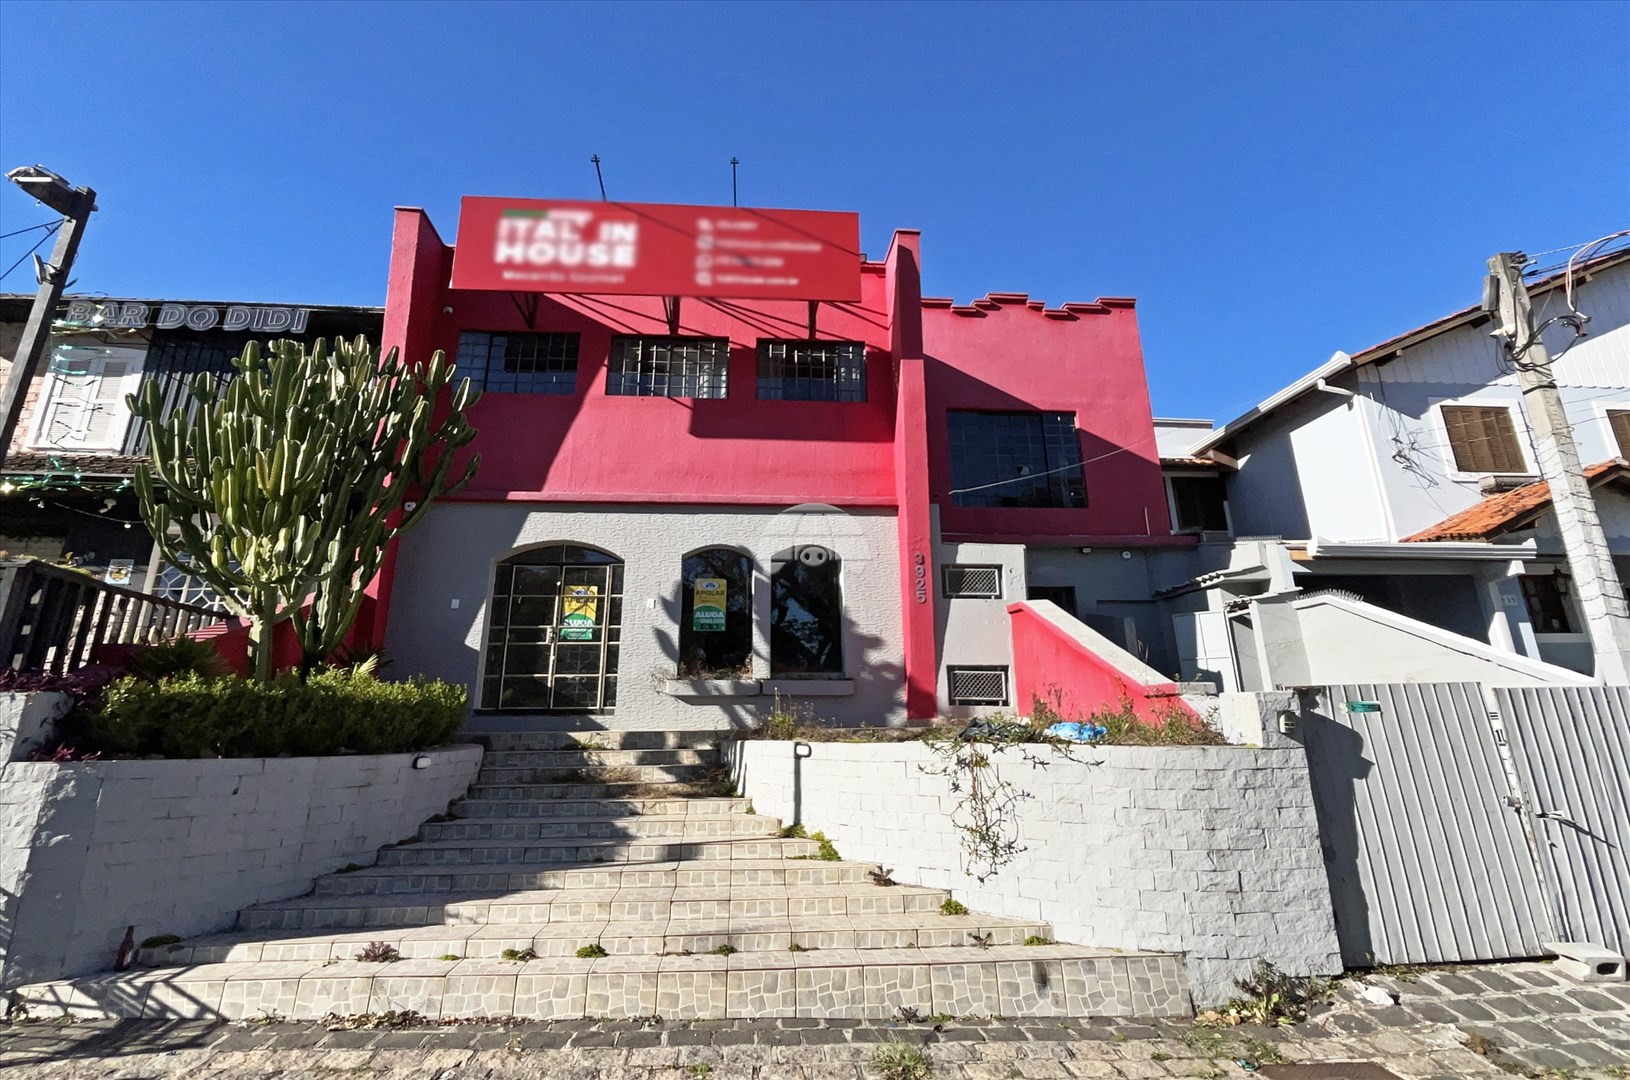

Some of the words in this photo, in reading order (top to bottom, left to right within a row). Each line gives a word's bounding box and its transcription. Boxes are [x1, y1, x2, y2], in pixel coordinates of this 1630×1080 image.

[599, 222, 638, 243] IN
[494, 240, 637, 268] HOUSE
[66, 301, 150, 329] BAR
[156, 303, 219, 331] DO
[223, 305, 310, 334] DIDI
[914, 551, 927, 604] 3925
